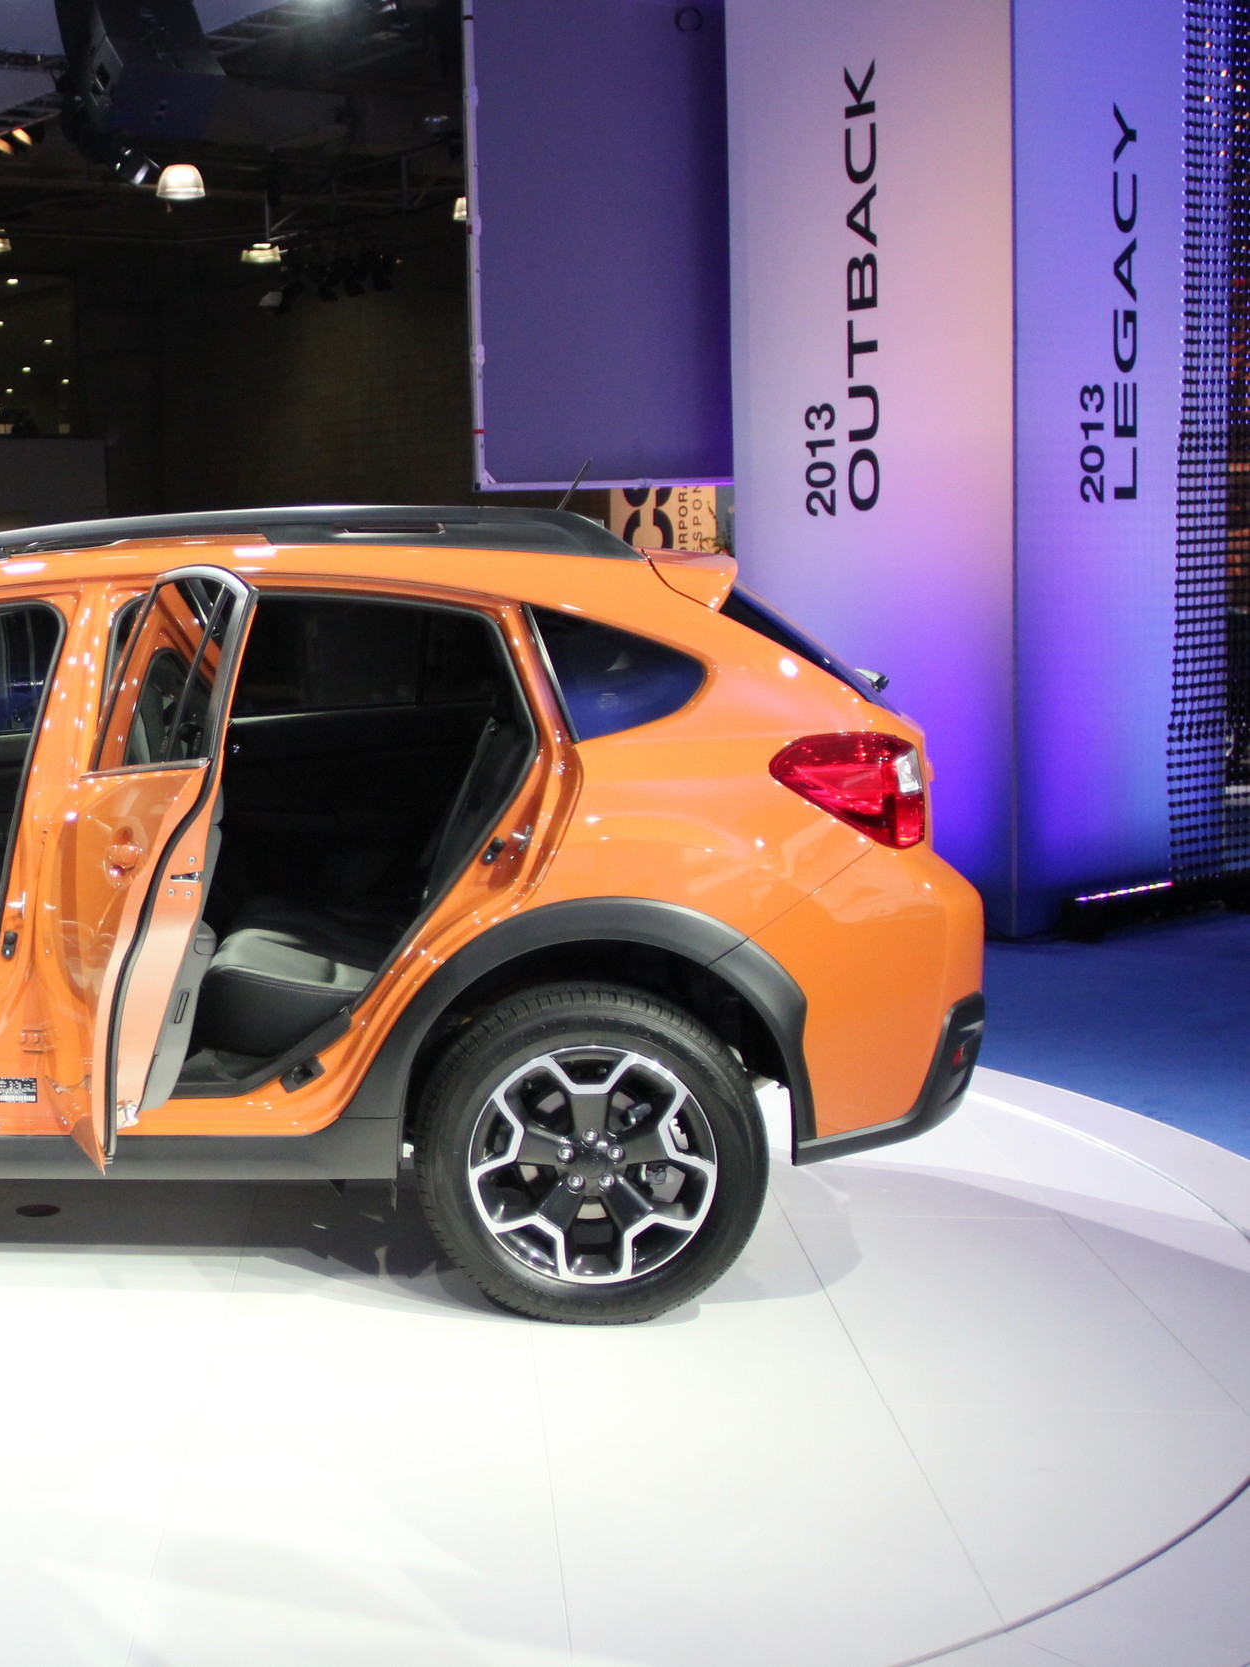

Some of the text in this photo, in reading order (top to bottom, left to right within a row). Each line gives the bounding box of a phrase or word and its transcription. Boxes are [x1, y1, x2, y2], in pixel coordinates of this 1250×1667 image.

[844, 57, 880, 512] OUTBACK
[1113, 101, 1137, 500] LEGACY
[804, 402, 836, 517] 2013
[1080, 383, 1105, 504] 2013
